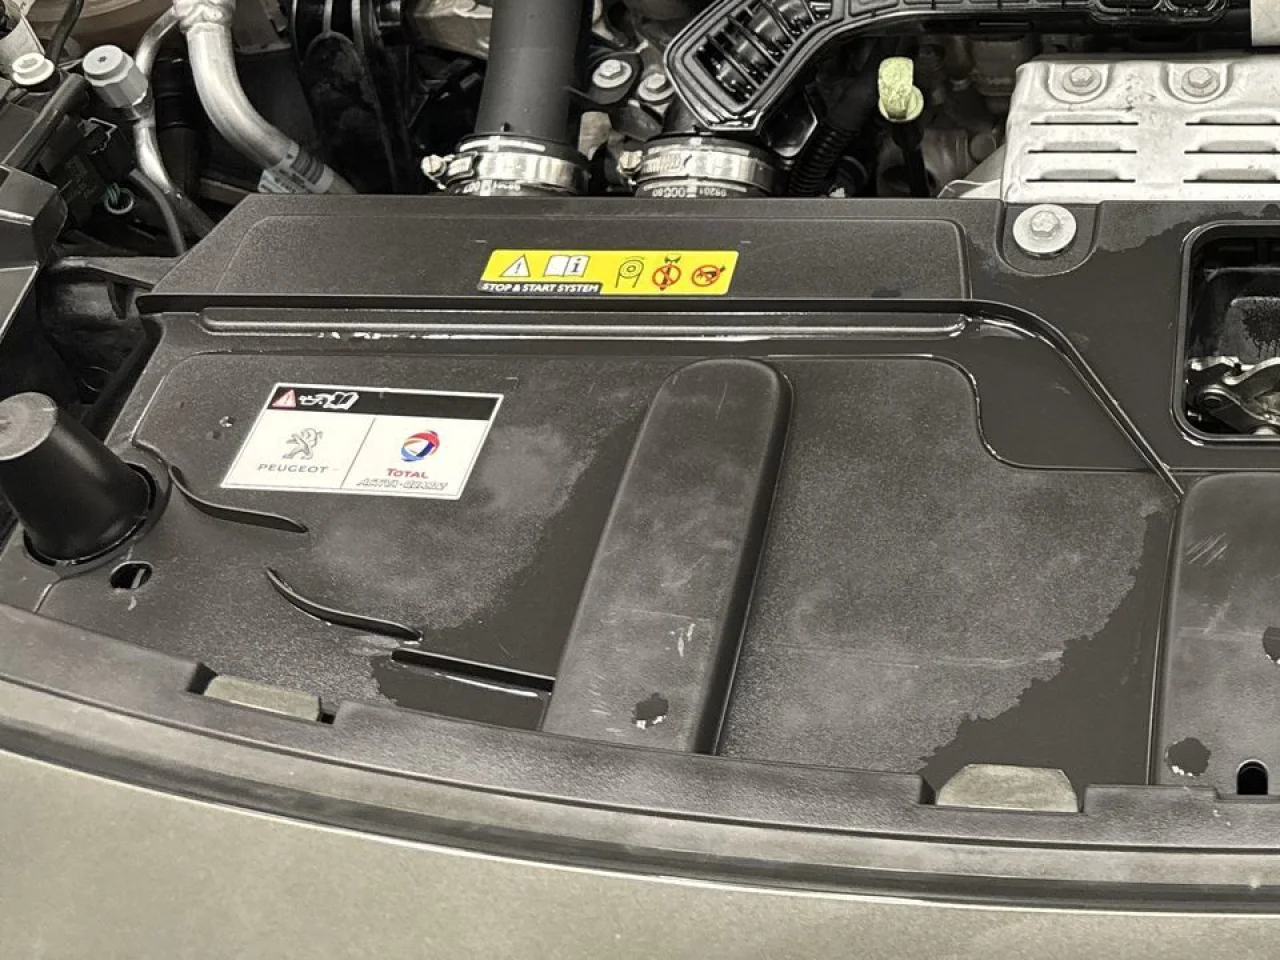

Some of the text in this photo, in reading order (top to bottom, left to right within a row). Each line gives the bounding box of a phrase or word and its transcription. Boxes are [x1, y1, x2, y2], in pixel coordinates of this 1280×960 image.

[482, 283, 600, 293] STOP & START SYSTEM
[256, 463, 329, 474] PEUGEOT
[386, 468, 429, 479] TOTAL
